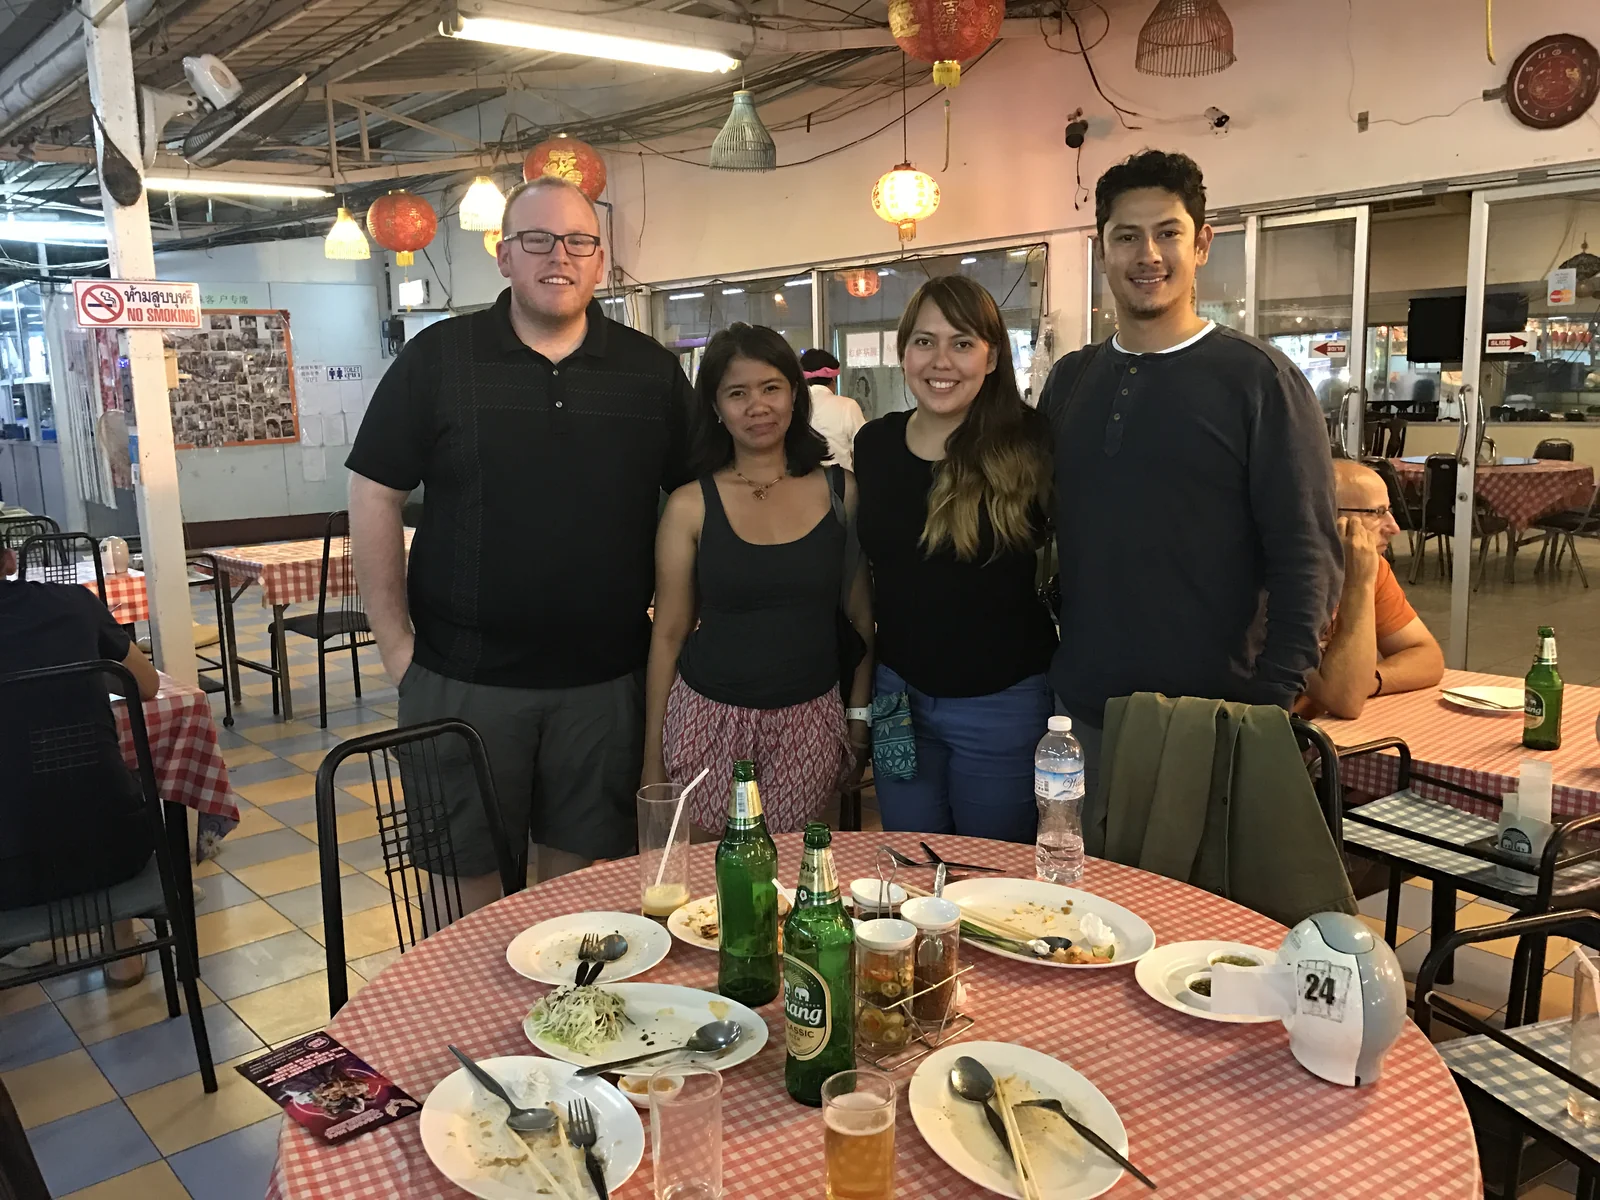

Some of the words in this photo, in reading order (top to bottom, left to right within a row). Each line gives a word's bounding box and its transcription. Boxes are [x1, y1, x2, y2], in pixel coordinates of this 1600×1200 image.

[127, 308, 143, 322] NO
[147, 308, 196, 323] SMOKING
[1304, 973, 1336, 1006] 24
[784, 994, 823, 1026] hang
